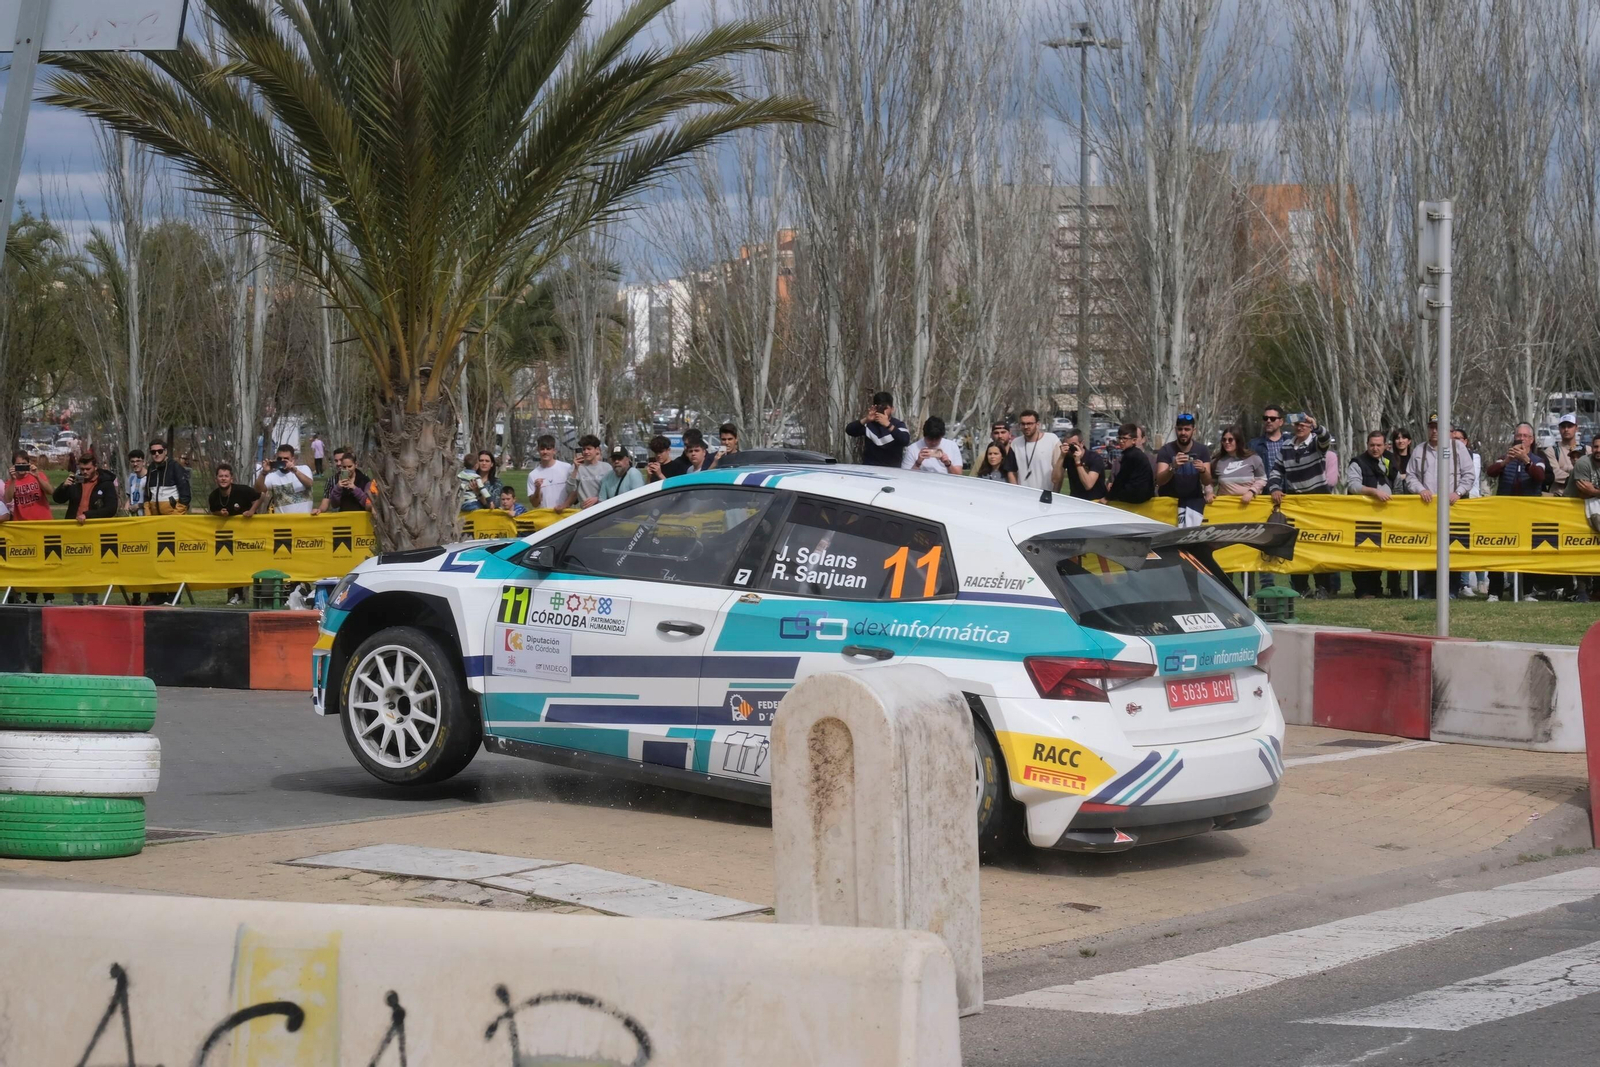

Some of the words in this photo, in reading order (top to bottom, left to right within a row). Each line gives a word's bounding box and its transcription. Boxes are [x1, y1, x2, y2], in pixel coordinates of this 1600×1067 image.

[1300, 531, 1341, 542] Recalvi
[1387, 534, 1429, 545] Recalvi
[1475, 535, 1517, 546] Recalvi
[121, 543, 148, 553] Recalvi
[178, 541, 206, 552] Recalvi
[236, 539, 265, 550] Recalvi
[295, 538, 324, 549] Recalvi
[9, 547, 36, 556] Recalvi
[64, 545, 92, 555] Recalvi
[775, 545, 791, 562] J.
[795, 546, 858, 570] Solans
[771, 563, 790, 581] R.
[794, 565, 867, 590] Sanjuan
[883, 545, 943, 599] 11
[502, 586, 529, 625] 11
[531, 610, 587, 628] CÓRDOBA
[590, 616, 622, 625] PATRIMONIO
[589, 622, 625, 633] HUMANIDAD
[853, 617, 1011, 644] dexinformática
[526, 635, 560, 646] Diputación
[534, 644, 560, 654] Córdoba
[1199, 647, 1255, 666] dexinformática
[542, 664, 569, 674] IMDECO
[1170, 685, 1178, 703] S
[1181, 681, 1209, 701] 5635
[1212, 679, 1232, 698] BCH
[1032, 742, 1082, 768] RACC
[1023, 765, 1087, 791] PIRELLI
